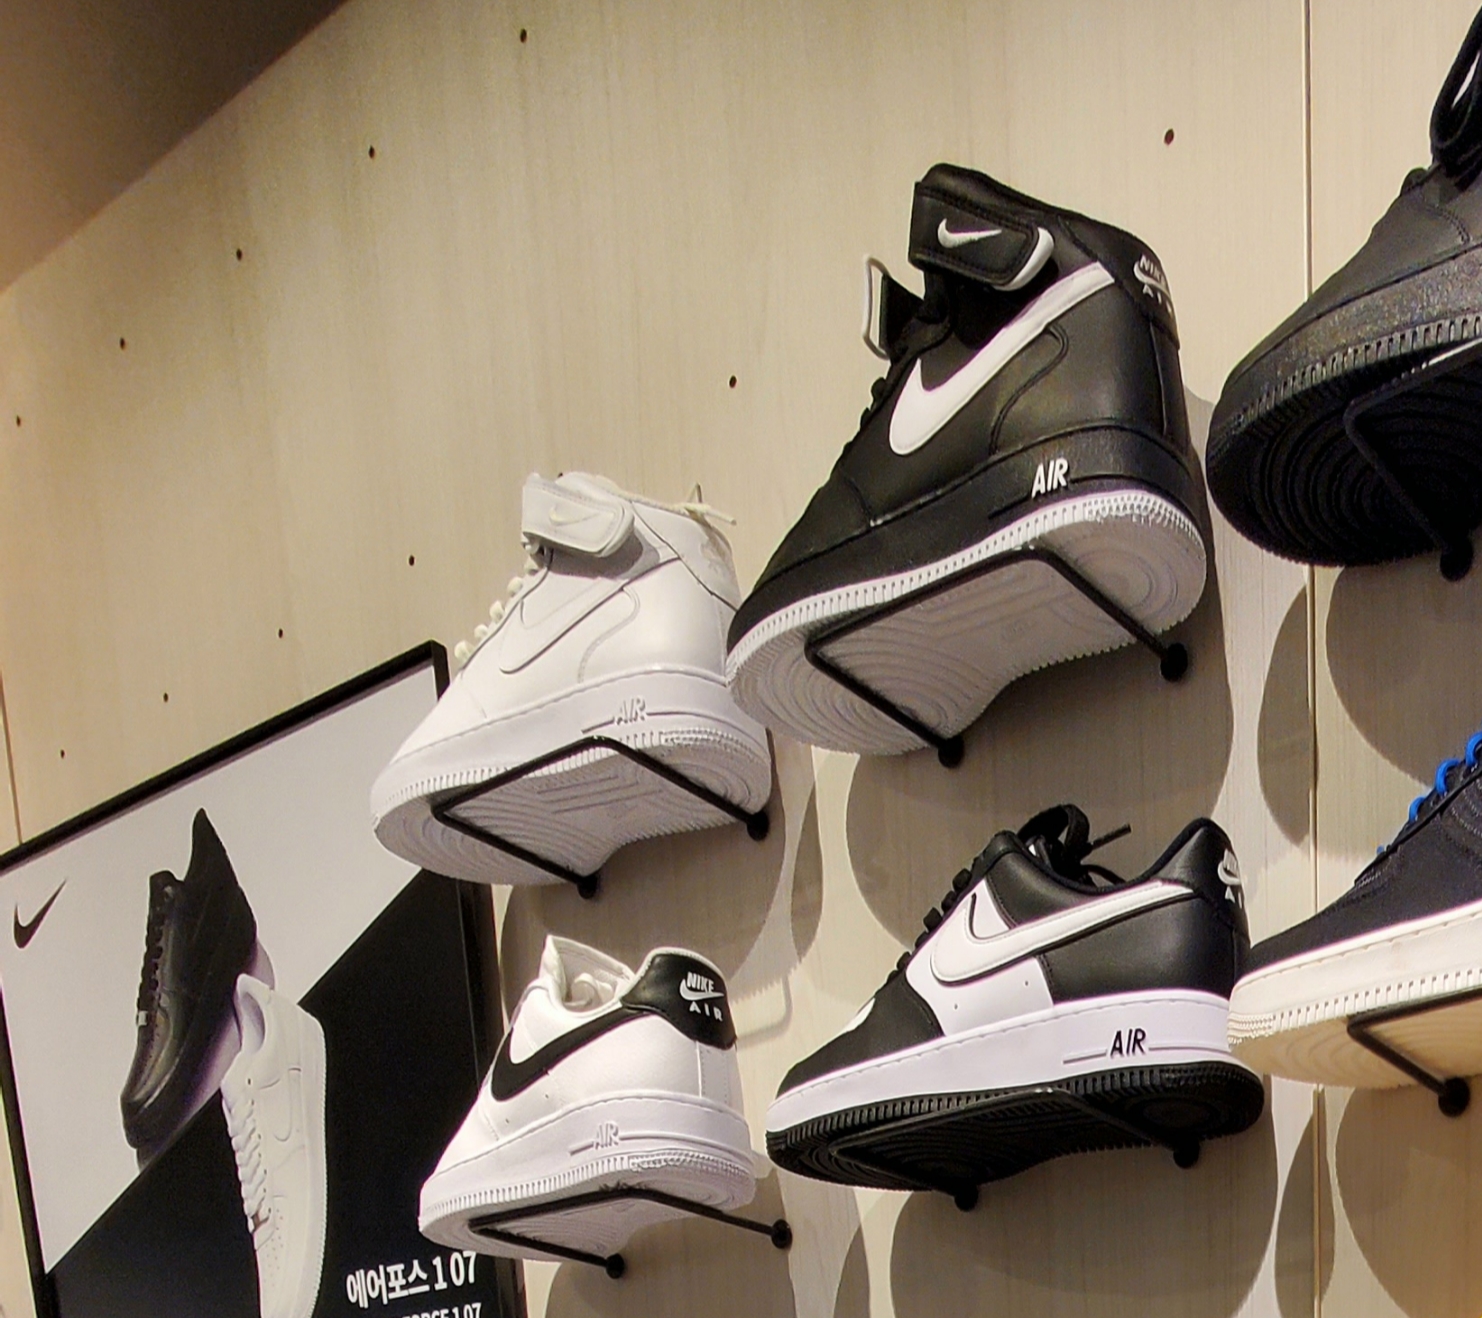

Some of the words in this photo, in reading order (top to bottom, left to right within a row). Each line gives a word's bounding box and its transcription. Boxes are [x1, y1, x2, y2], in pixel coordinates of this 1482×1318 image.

[1031, 457, 1068, 499] AIR
[616, 696, 647, 726] AIR
[687, 971, 715, 993] NIKE
[689, 1001, 723, 1022] AIR
[1109, 1027, 1146, 1059] AIR
[595, 1122, 619, 1150] AIR
[346, 1259, 430, 1309] 에어포스
[432, 1256, 448, 1291] 1
[450, 1250, 477, 1287] 07
